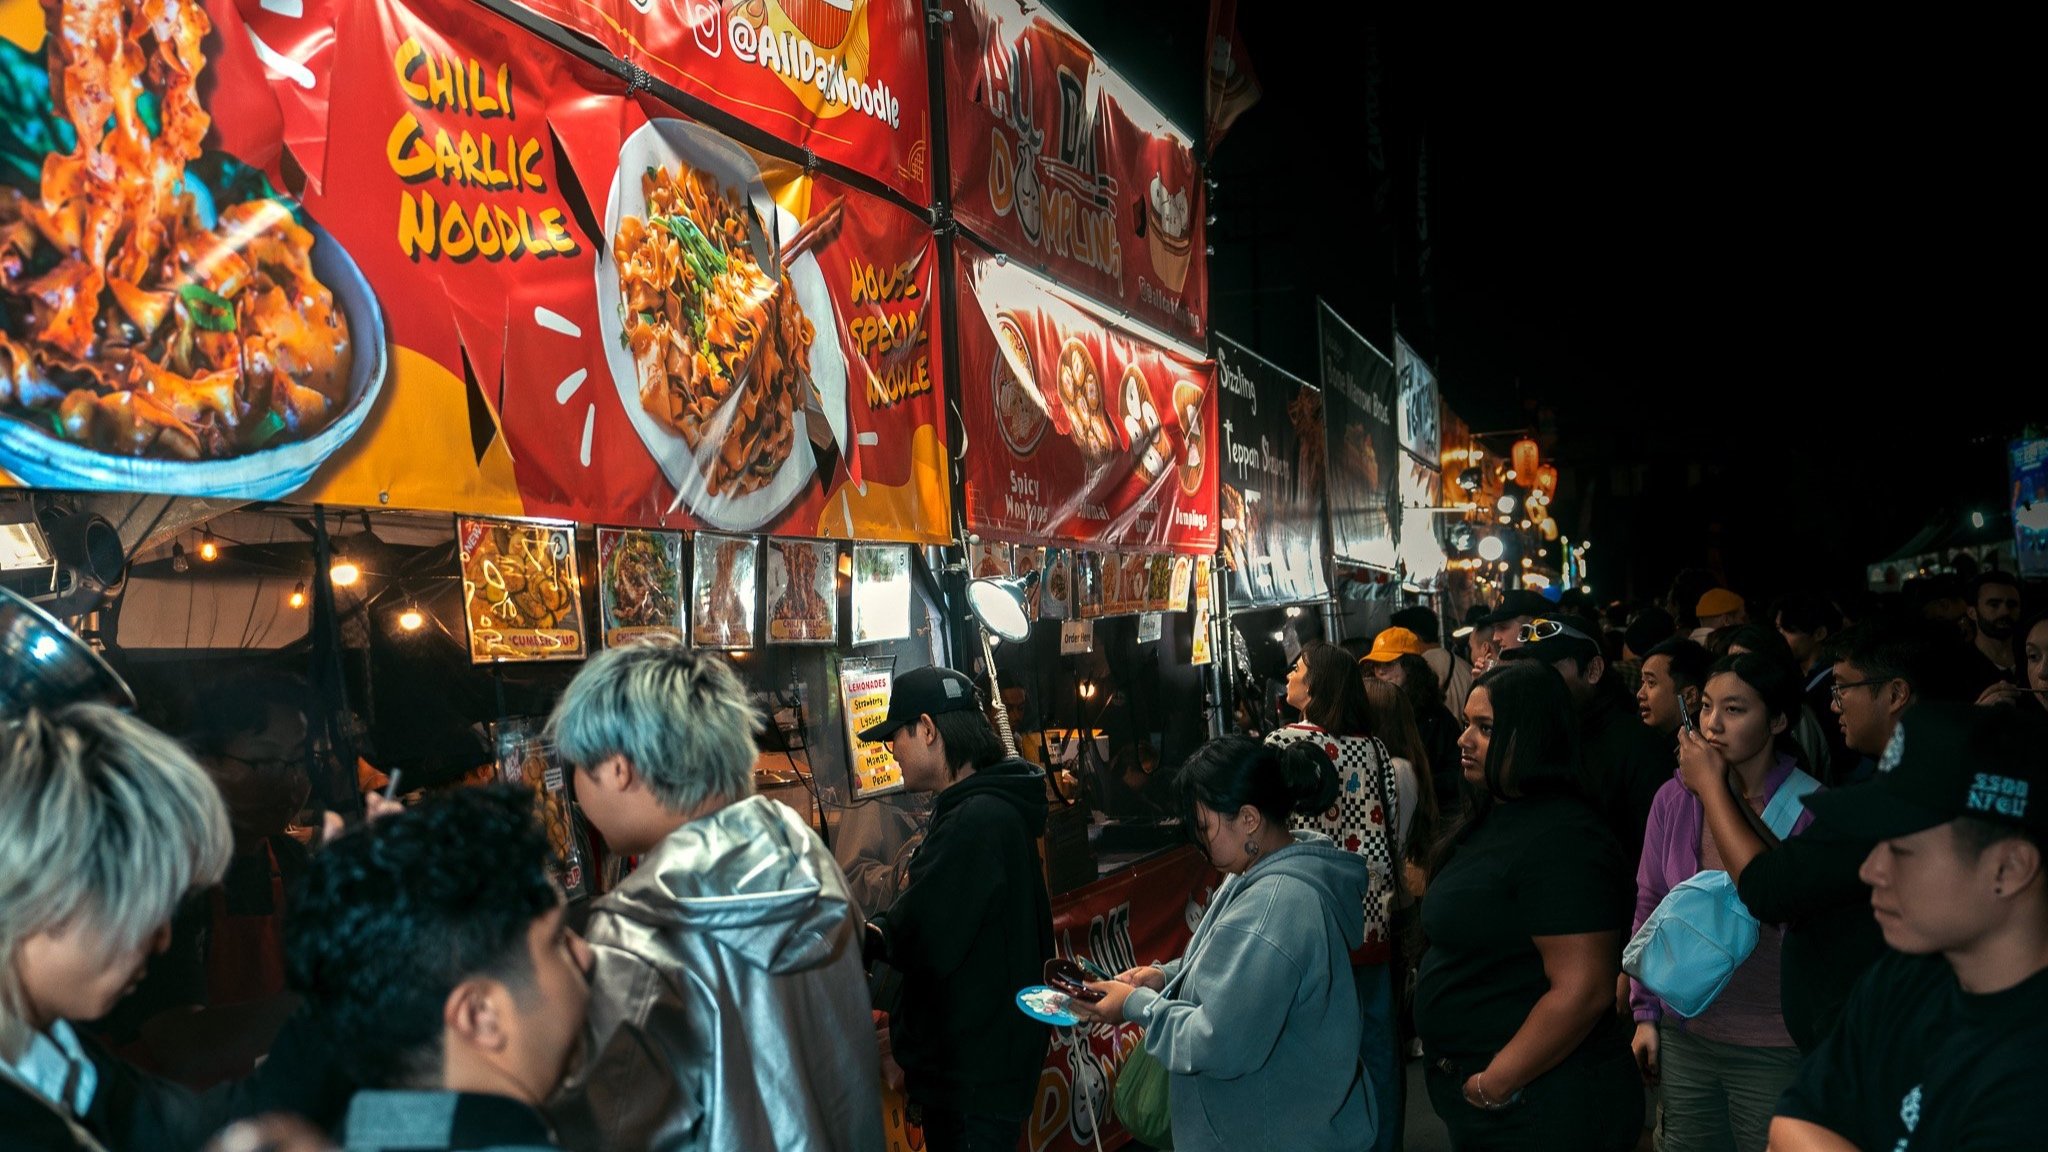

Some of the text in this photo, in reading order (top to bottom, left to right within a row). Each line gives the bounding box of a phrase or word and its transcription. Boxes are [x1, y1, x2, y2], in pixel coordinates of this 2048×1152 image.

[394, 37, 512, 118] CHILI
[728, 21, 900, 130] @AllDatNoodle
[387, 116, 544, 189] GARLIC
[398, 190, 579, 259] NOODLE
[850, 257, 918, 303] HOUSE
[1218, 346, 1257, 416] Sizzling
[1223, 419, 1259, 481] Teppan
[1010, 469, 1040, 502] Spicy
[1004, 493, 1049, 524] Wontons
[464, 522, 483, 555] NEW
[601, 533, 616, 561] NEW
[667, 541, 675, 559] 9
[823, 550, 832, 561] 15
[899, 553, 905, 567] 5
[1064, 632, 1080, 644] Order
[848, 678, 886, 692] LEMONADES
[854, 697, 883, 710] Strawberry
[860, 714, 882, 728] Lychee
[866, 753, 889, 767] Mango
[872, 772, 892, 787] Peach
